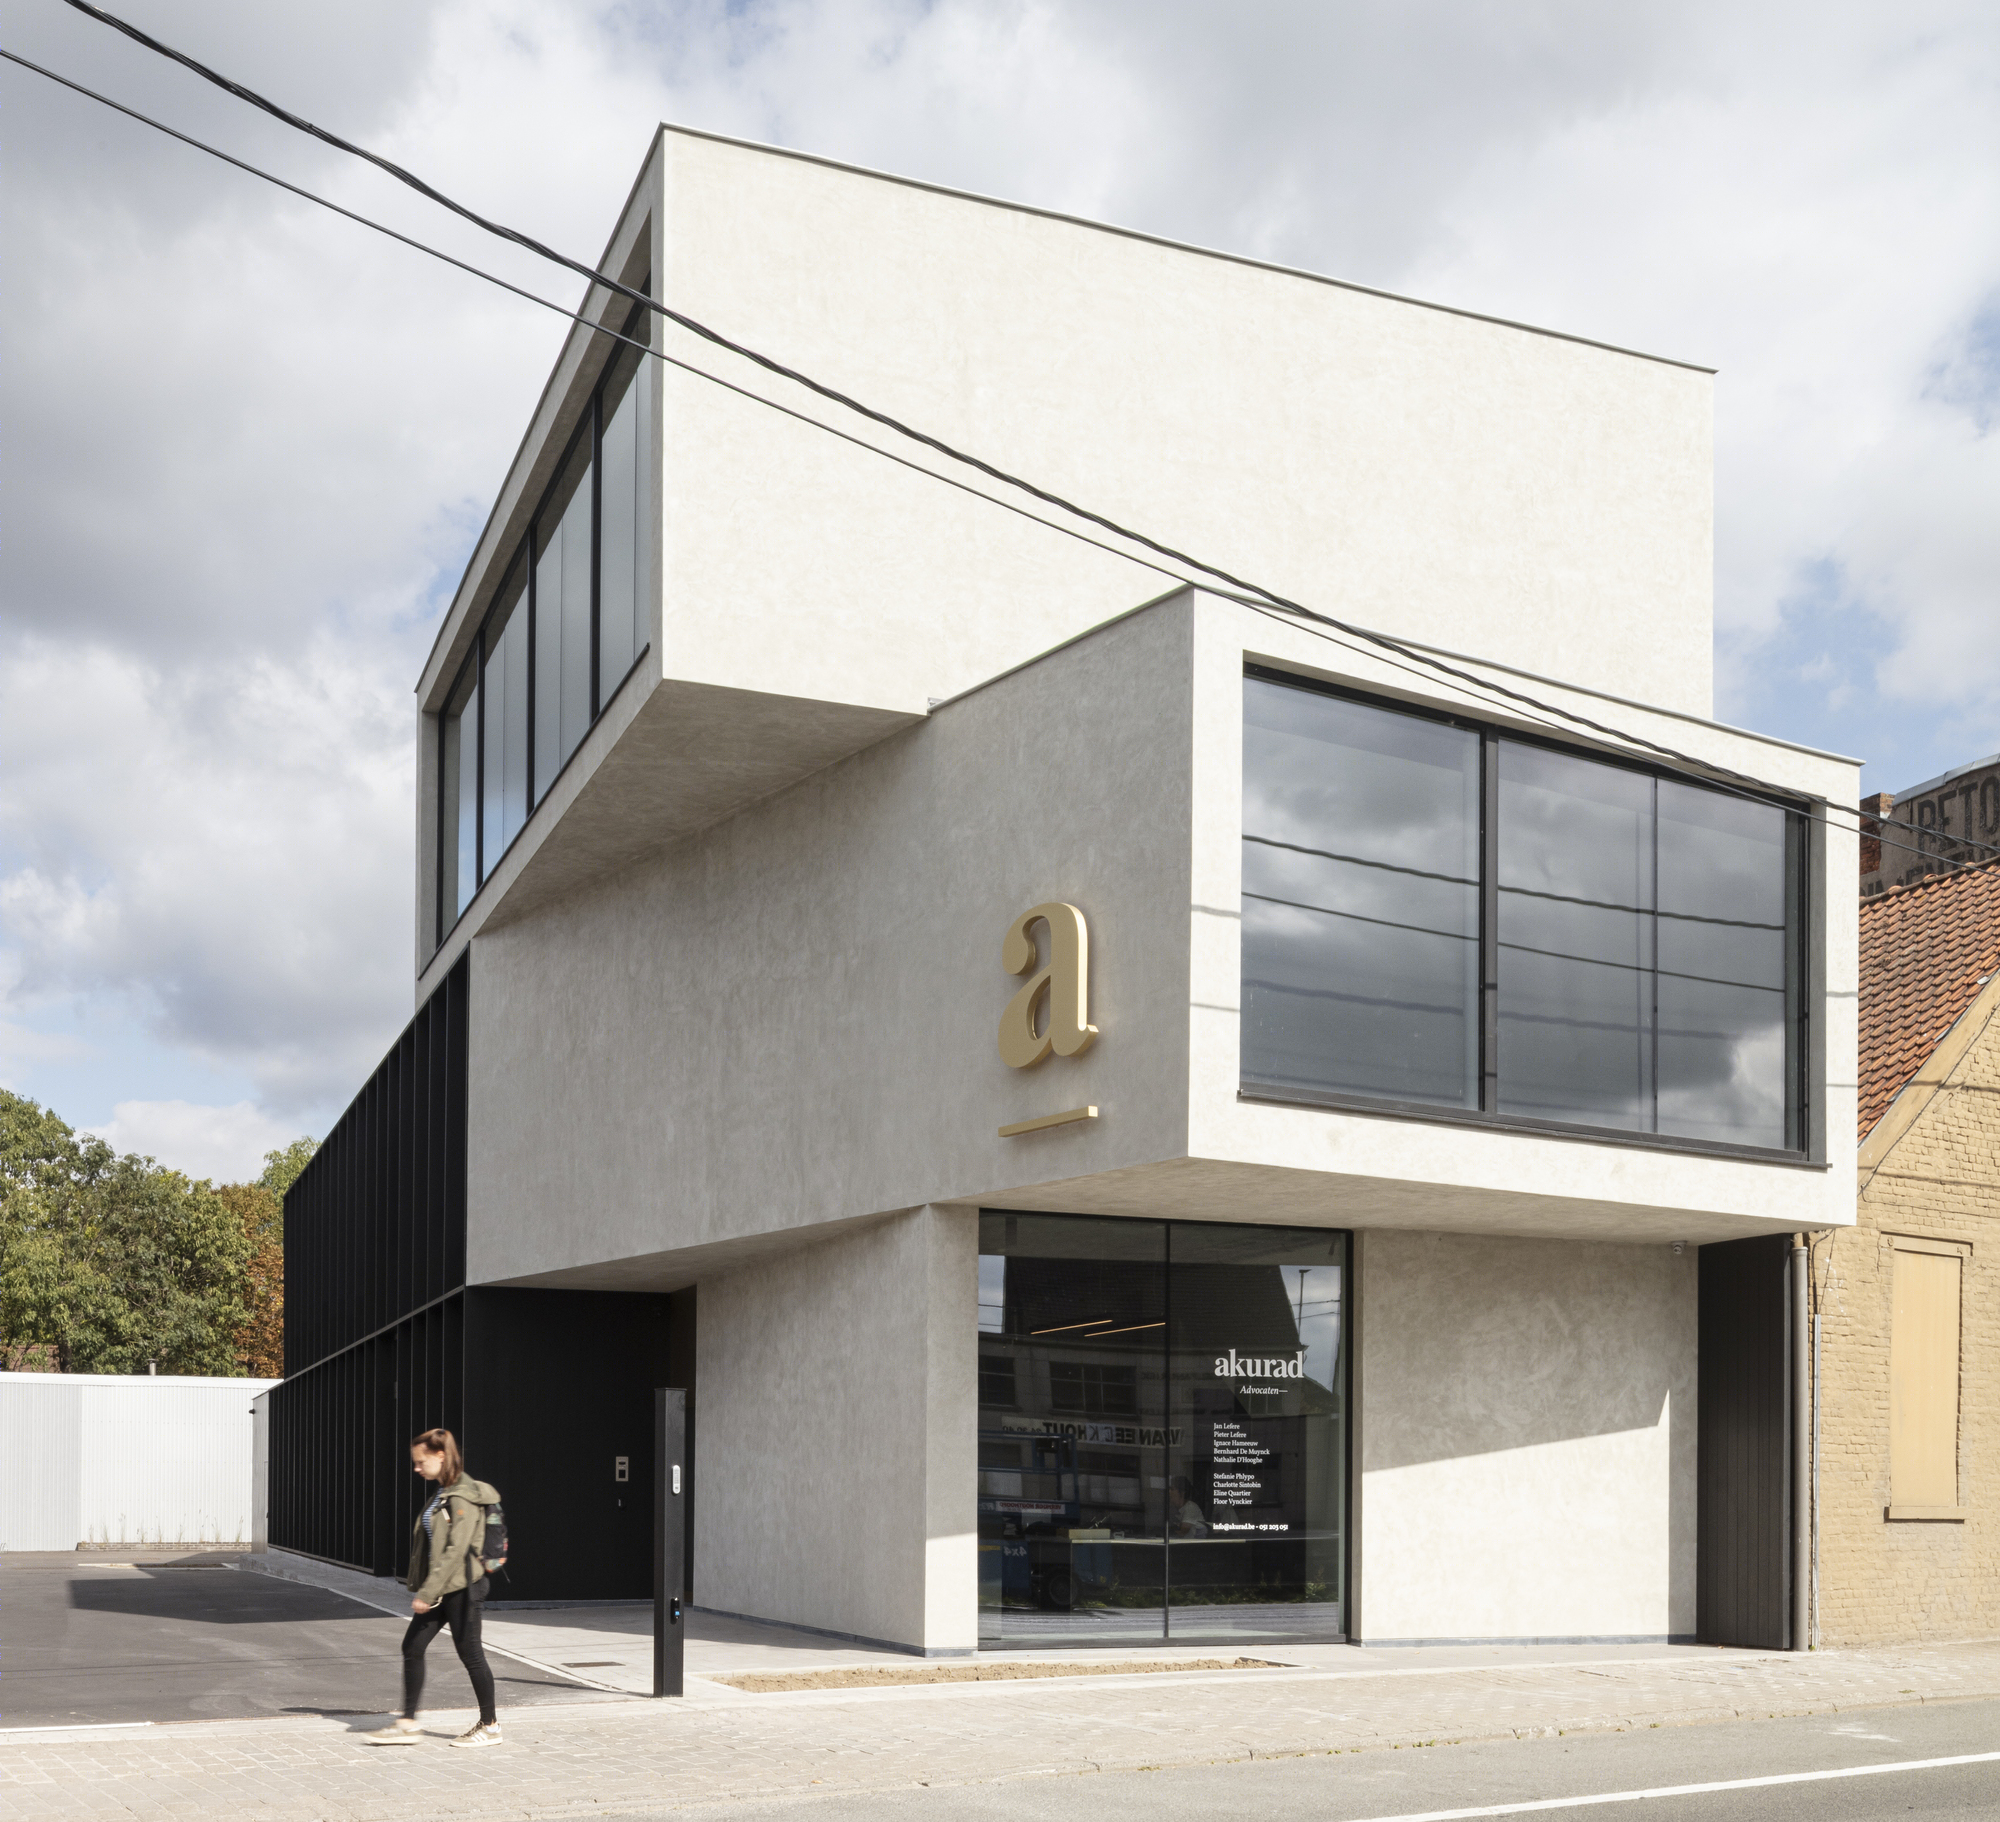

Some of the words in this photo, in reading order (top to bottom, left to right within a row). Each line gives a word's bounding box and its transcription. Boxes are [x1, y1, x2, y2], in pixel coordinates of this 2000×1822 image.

[998, 902, 1099, 1068] a
[1214, 1348, 1304, 1379] akurad
[1213, 1422, 1222, 1431] Jan
[1223, 1422, 1240, 1430] Lefere
[1213, 1440, 1231, 1448] Ignace
[1248, 1448, 1270, 1456] Muynck
[1235, 1473, 1255, 1481] Phlypo
[1228, 1489, 1251, 1498] Quartier
[1228, 1498, 1253, 1507] Vynckier
[1212, 1523, 1255, 1532] info@akurad.be
